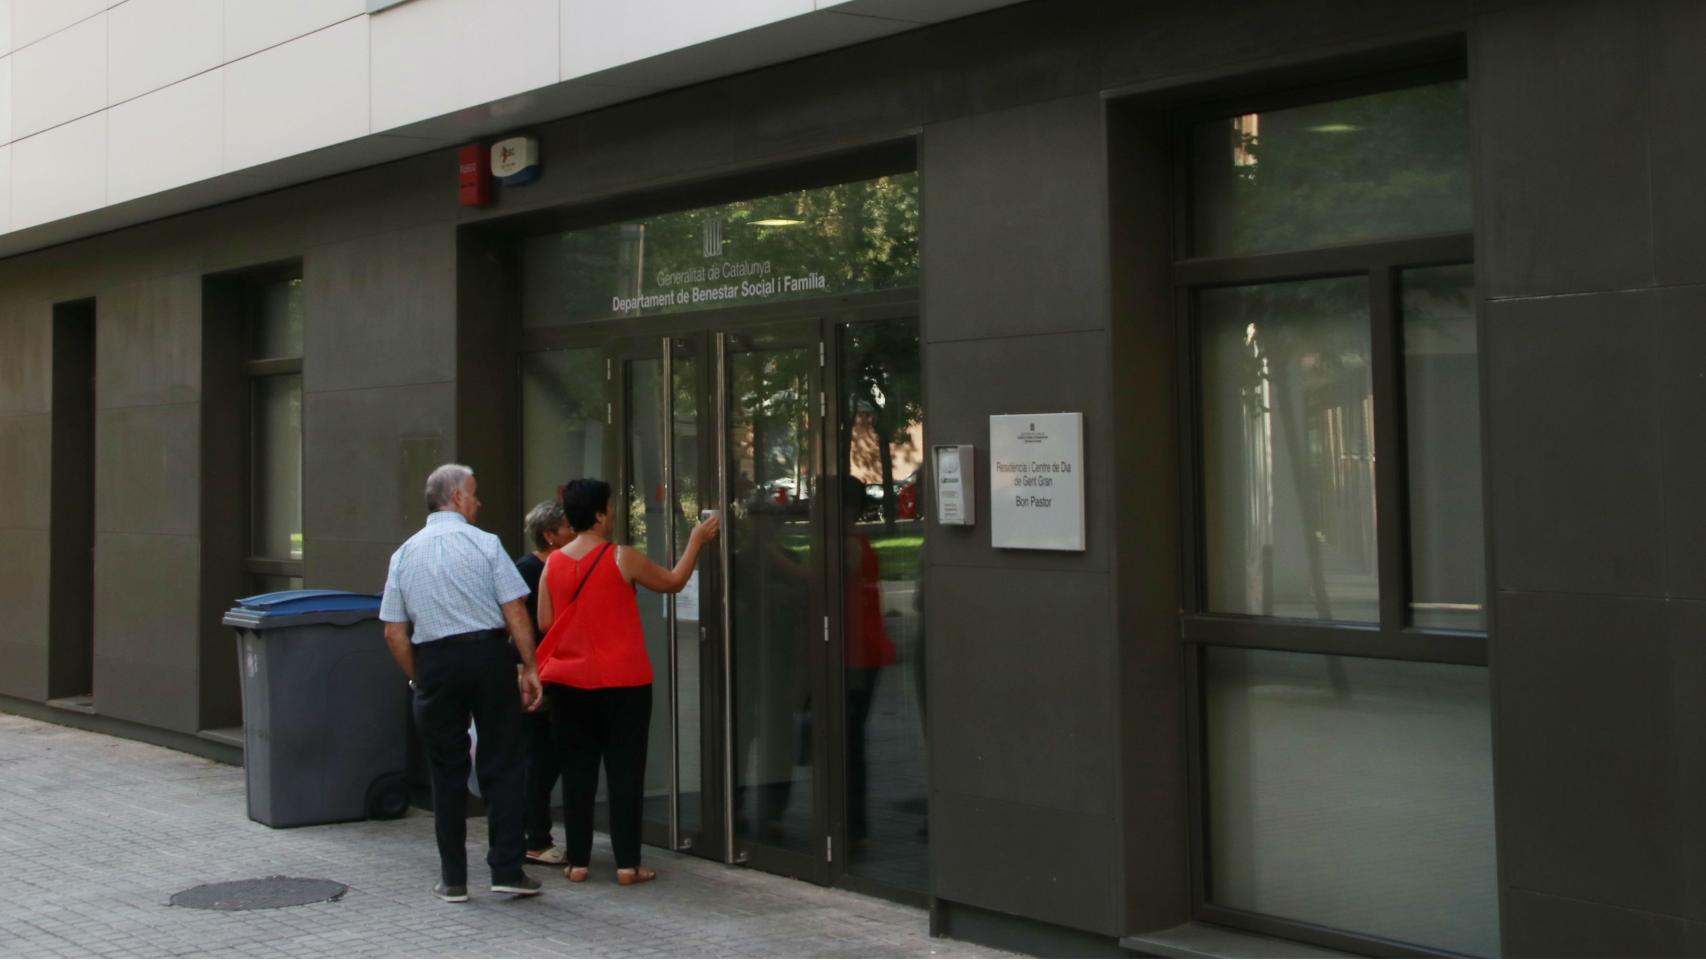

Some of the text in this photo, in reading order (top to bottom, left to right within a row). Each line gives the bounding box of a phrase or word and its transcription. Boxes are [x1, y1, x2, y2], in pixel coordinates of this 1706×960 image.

[656, 260, 771, 287] Generalitat de Catalunya
[612, 272, 826, 312] Departament de Benestar Social i Família
[1032, 461, 1051, 473] Centre
[1052, 462, 1060, 473] de
[1061, 461, 1072, 473] Dia
[1014, 475, 1053, 487] de Gent Gran
[1016, 495, 1052, 508] Bon Pastor
